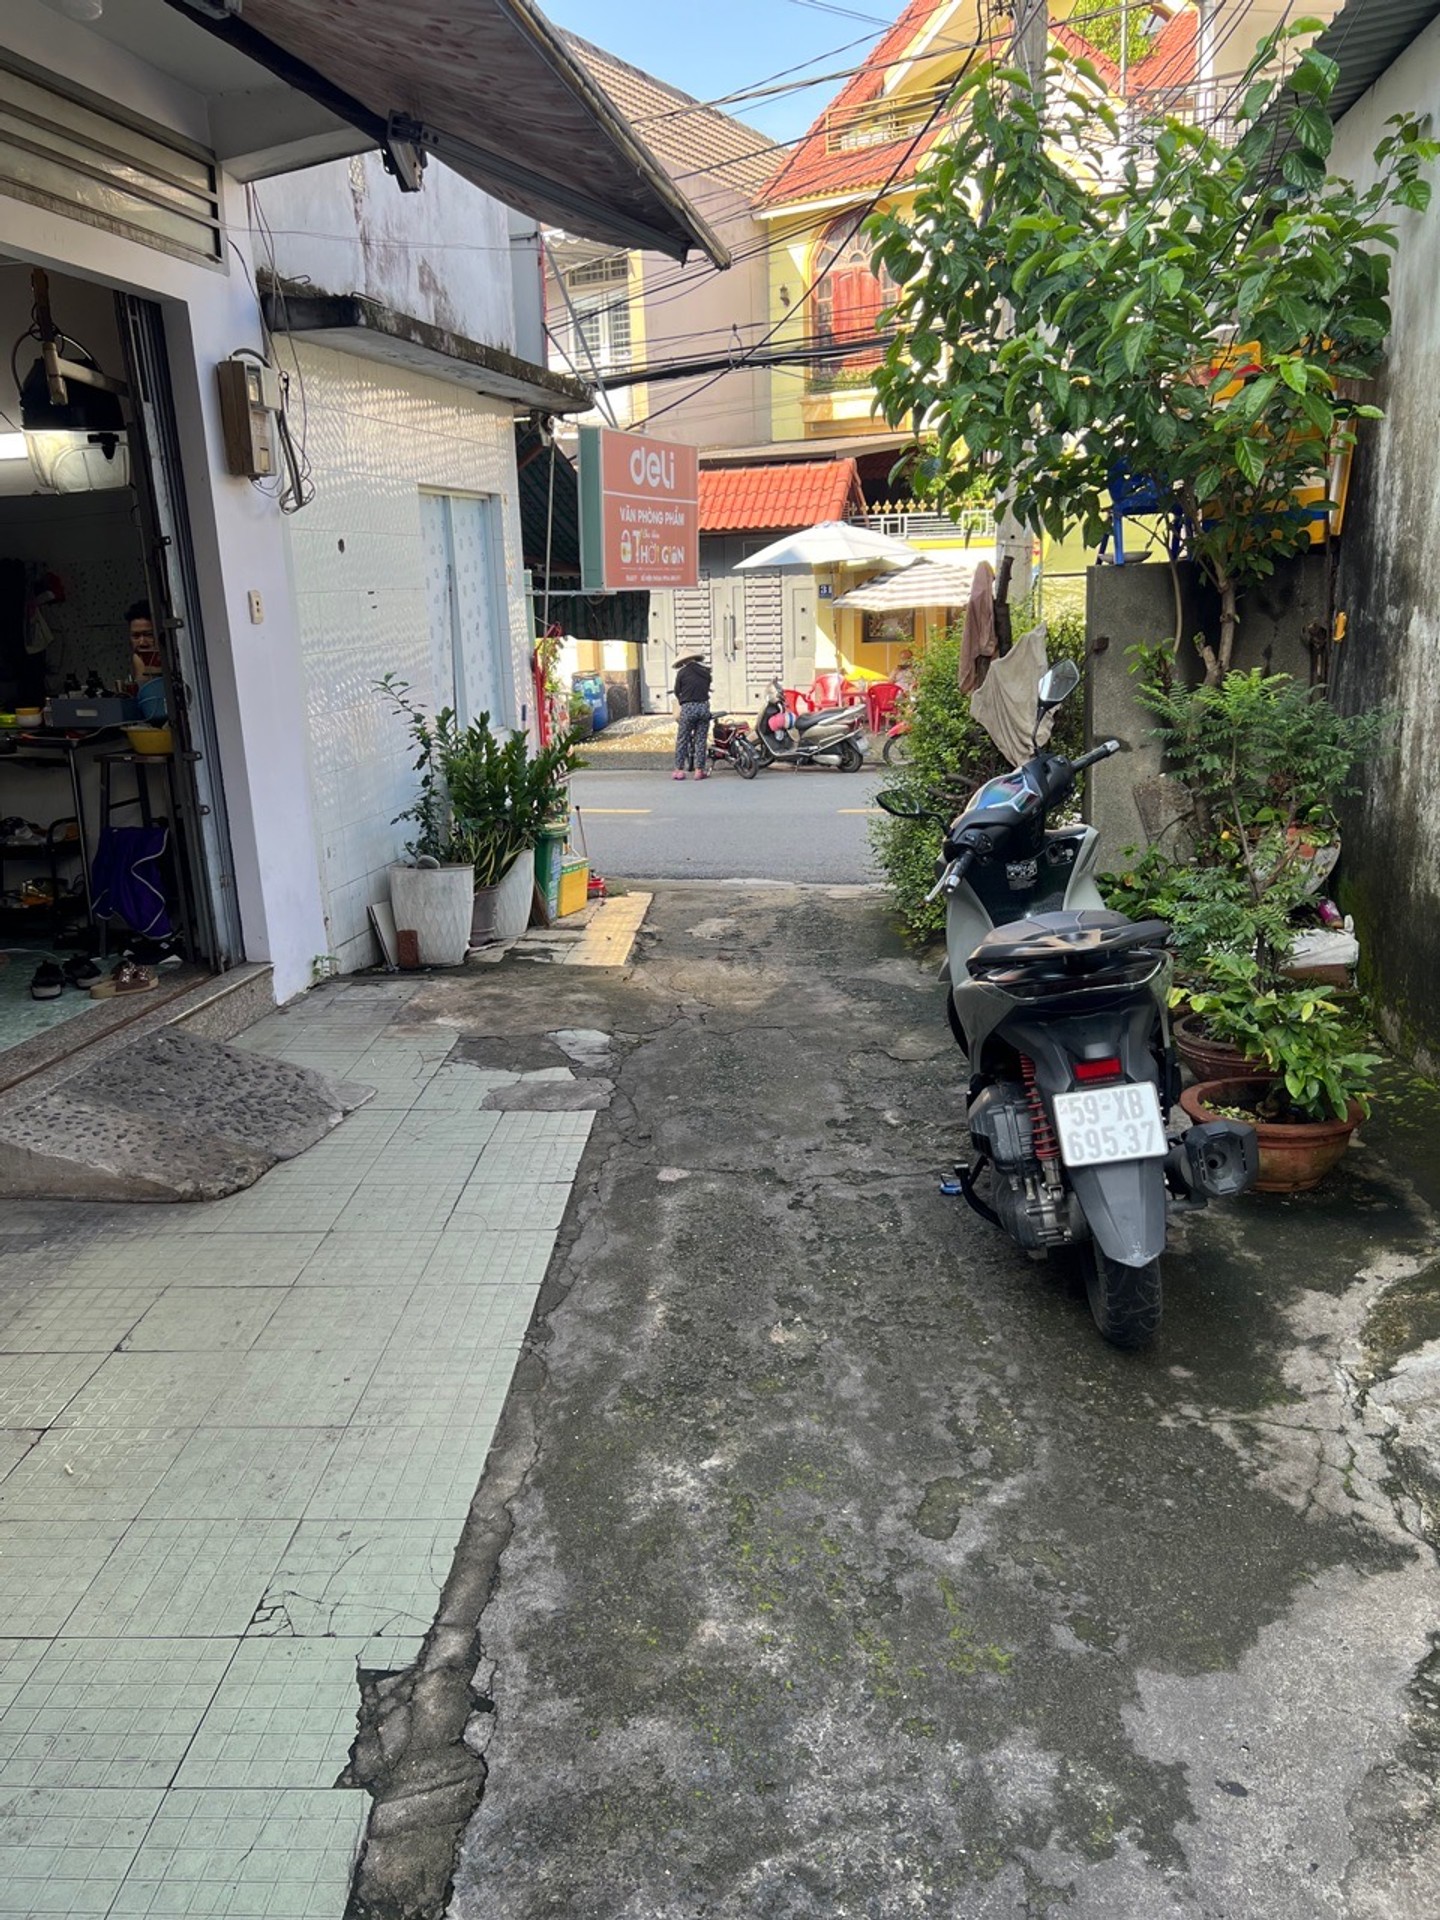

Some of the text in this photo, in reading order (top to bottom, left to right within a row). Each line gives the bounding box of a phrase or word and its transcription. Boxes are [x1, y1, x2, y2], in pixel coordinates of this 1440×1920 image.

[630, 447, 674, 489] deli
[638, 507, 663, 525] PHÒNG
[1068, 1089, 1144, 1127] 59-XB
[1067, 1120, 1155, 1161] 695.37
